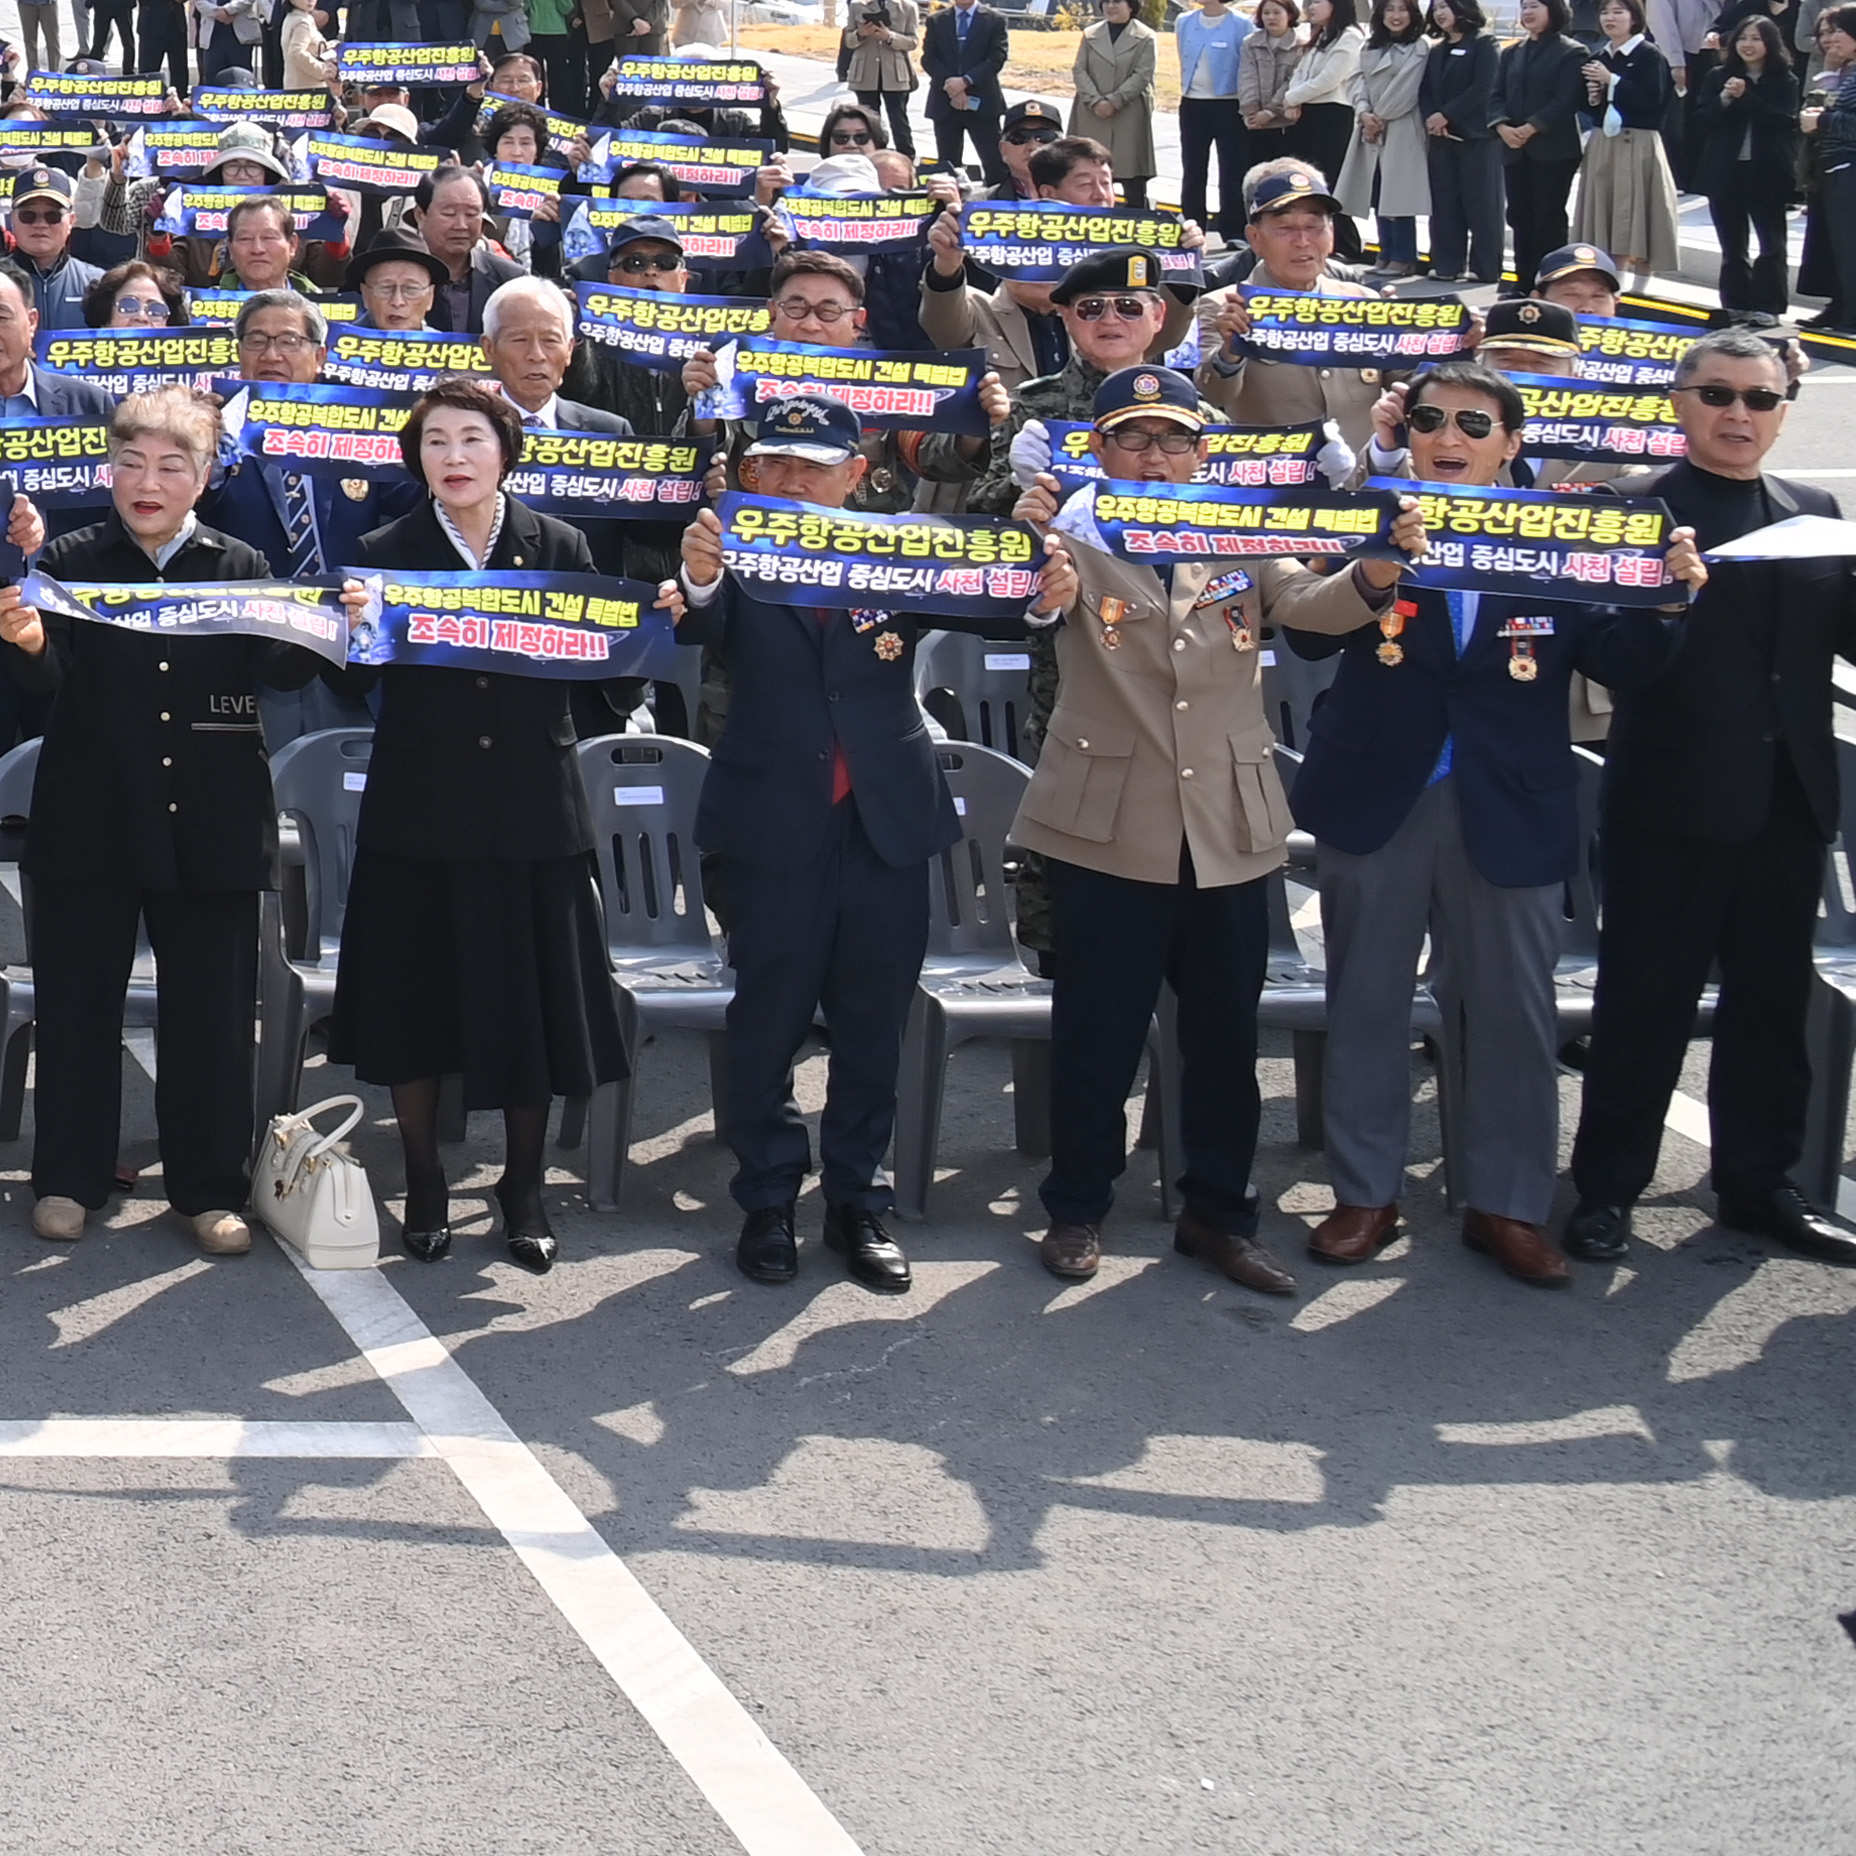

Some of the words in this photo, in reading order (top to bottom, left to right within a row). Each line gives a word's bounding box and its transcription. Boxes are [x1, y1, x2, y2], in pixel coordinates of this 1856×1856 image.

[344, 47, 475, 66] 우주항공산업진흥원
[623, 62, 758, 83] 우주항공산업진흥원
[201, 93, 327, 111] 우주항공산업진흥원
[156, 149, 198, 167] 조속히
[702, 148, 726, 165] 건설
[317, 159, 359, 181] 조속히
[357, 167, 421, 188] 제정하라!!
[877, 200, 903, 218] 건설
[691, 216, 717, 233] 건설
[794, 218, 842, 241] 조속히
[841, 218, 920, 242] 제정하라!!
[969, 212, 1181, 248] 우주항공산업진흥원
[1247, 295, 1463, 328] 우주항공산업진흥원
[579, 321, 665, 355] 우주항공산업
[1333, 332, 1395, 353] 중심도시
[1394, 333, 1426, 354] 사천
[323, 361, 411, 391] 우주항공산업
[738, 350, 873, 380] 우주항공복합도시
[875, 360, 912, 383] 건설
[913, 363, 968, 387] 특별법
[132, 373, 191, 395] 중심도시
[249, 400, 377, 430] 우주항공복합도시
[262, 427, 330, 459] 조속히
[1521, 423, 1600, 448] 중심도시
[1600, 426, 1647, 454] 사천
[23, 465, 90, 493] 중심도시
[1228, 460, 1266, 486] 사천
[1267, 459, 1314, 485] 설립!
[550, 474, 618, 498] 중심도시
[618, 478, 656, 501] 사천
[1097, 494, 1263, 528] 우주항공복합도시
[1266, 507, 1309, 531] 건설
[1313, 508, 1379, 534] 특별법
[733, 509, 1032, 563] 우주항공산업진흥원
[1123, 529, 1212, 554] 조속히
[1470, 544, 1558, 578] 중심도시
[1561, 552, 1611, 583] 사천
[847, 564, 934, 593] 중심도시
[935, 568, 984, 595] 사천
[386, 587, 541, 616] 우주항공복합도시
[546, 592, 584, 622] 건설
[586, 597, 639, 628] 특별법
[407, 613, 489, 649] 조속히
[489, 619, 610, 661] 제정하라!!
